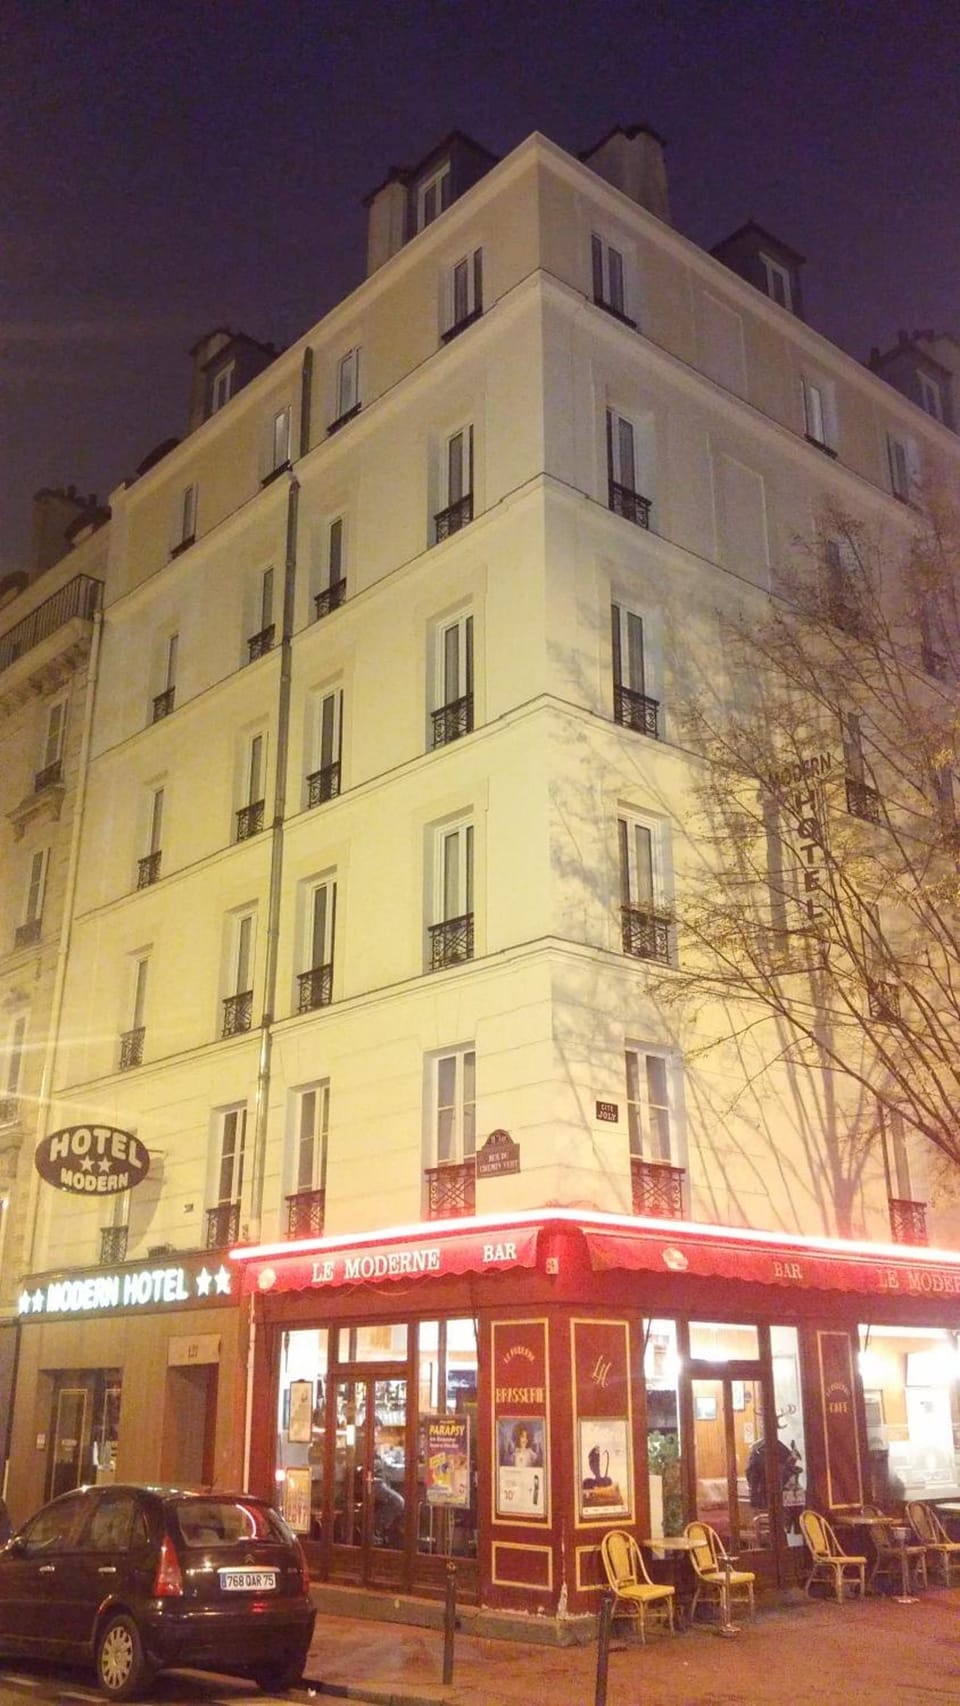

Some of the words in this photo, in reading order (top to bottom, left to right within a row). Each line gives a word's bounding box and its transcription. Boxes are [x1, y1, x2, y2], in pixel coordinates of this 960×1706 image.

[796, 788, 823, 920] HOTEL
[598, 1111, 616, 1120] JOLY
[50, 1128, 142, 1168] HOTEL
[61, 1168, 128, 1191] MODERN
[482, 1243, 517, 1262] BAR
[312, 1262, 334, 1282] LE
[344, 1248, 440, 1279] MODERNE
[773, 1262, 802, 1279] BAR
[876, 1269, 899, 1288] LE
[46, 1276, 119, 1312] MODERN
[123, 1268, 188, 1306] HOTEL
[495, 1387, 545, 1404] BRASSERIE
[263, 1575, 274, 1586] 75
